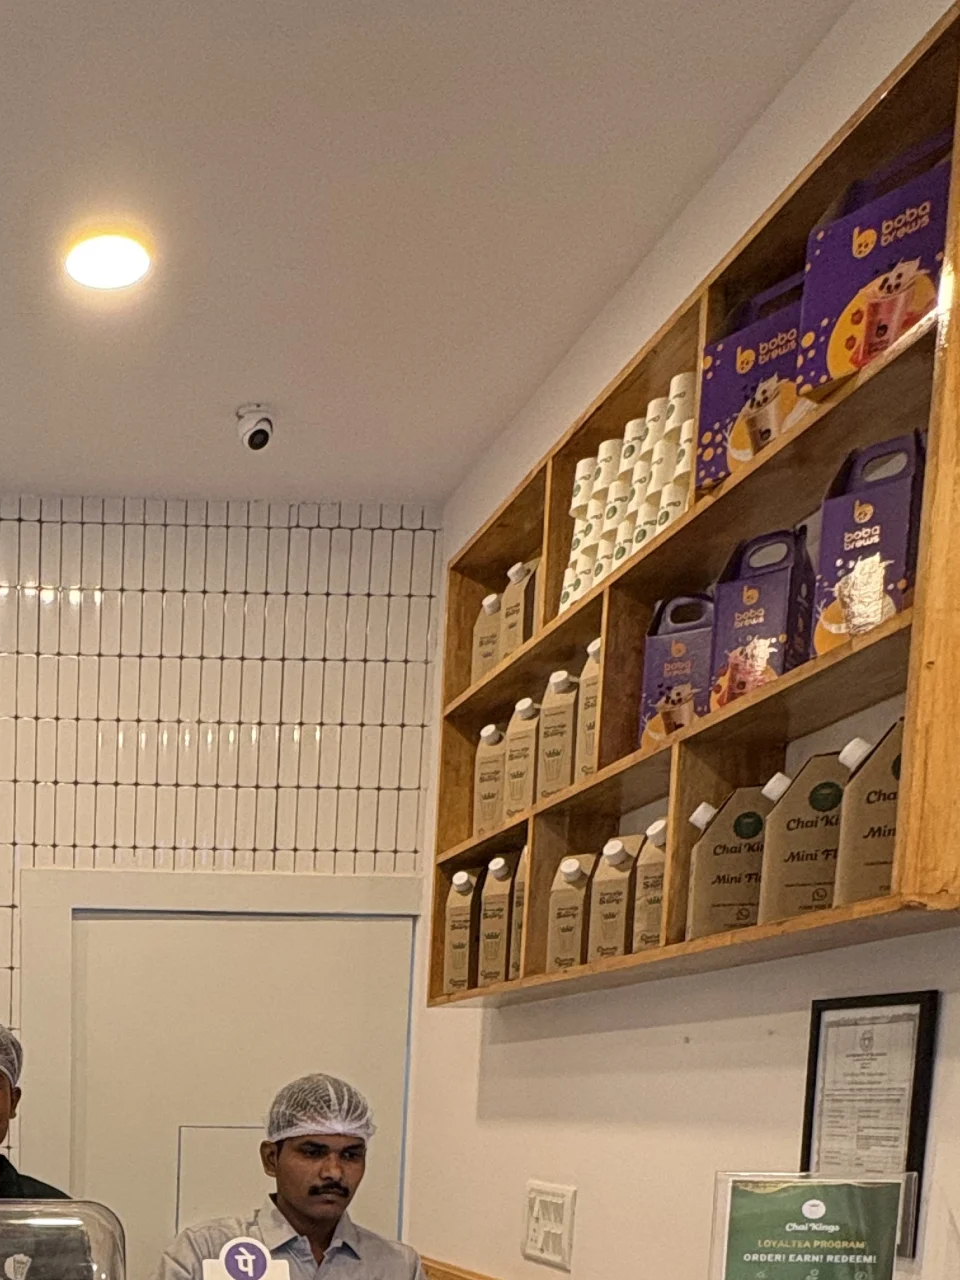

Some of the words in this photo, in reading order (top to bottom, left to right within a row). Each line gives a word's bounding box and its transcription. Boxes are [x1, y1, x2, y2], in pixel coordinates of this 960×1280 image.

[882, 201, 930, 234] boba
[881, 215, 929, 247] brews
[759, 329, 797, 354] boba
[844, 525, 880, 542] boba
[844, 535, 880, 551] brews
[734, 608, 765, 621] boba
[866, 788, 898, 804] Cha
[786, 816, 820, 831] Chai
[863, 825, 897, 839] Min
[713, 843, 743, 856] Chai
[784, 849, 819, 863] Mini
[711, 872, 742, 885] Mini
[785, 1223, 808, 1232] Chai
[809, 1223, 840, 1233] Kings
[758, 1239, 811, 1248] LOYALTEA
[813, 1240, 865, 1249] PROGRAM
[743, 1253, 785, 1262] ORDER!
[788, 1254, 823, 1263] EARN!
[826, 1254, 877, 1264] REDEEM!
